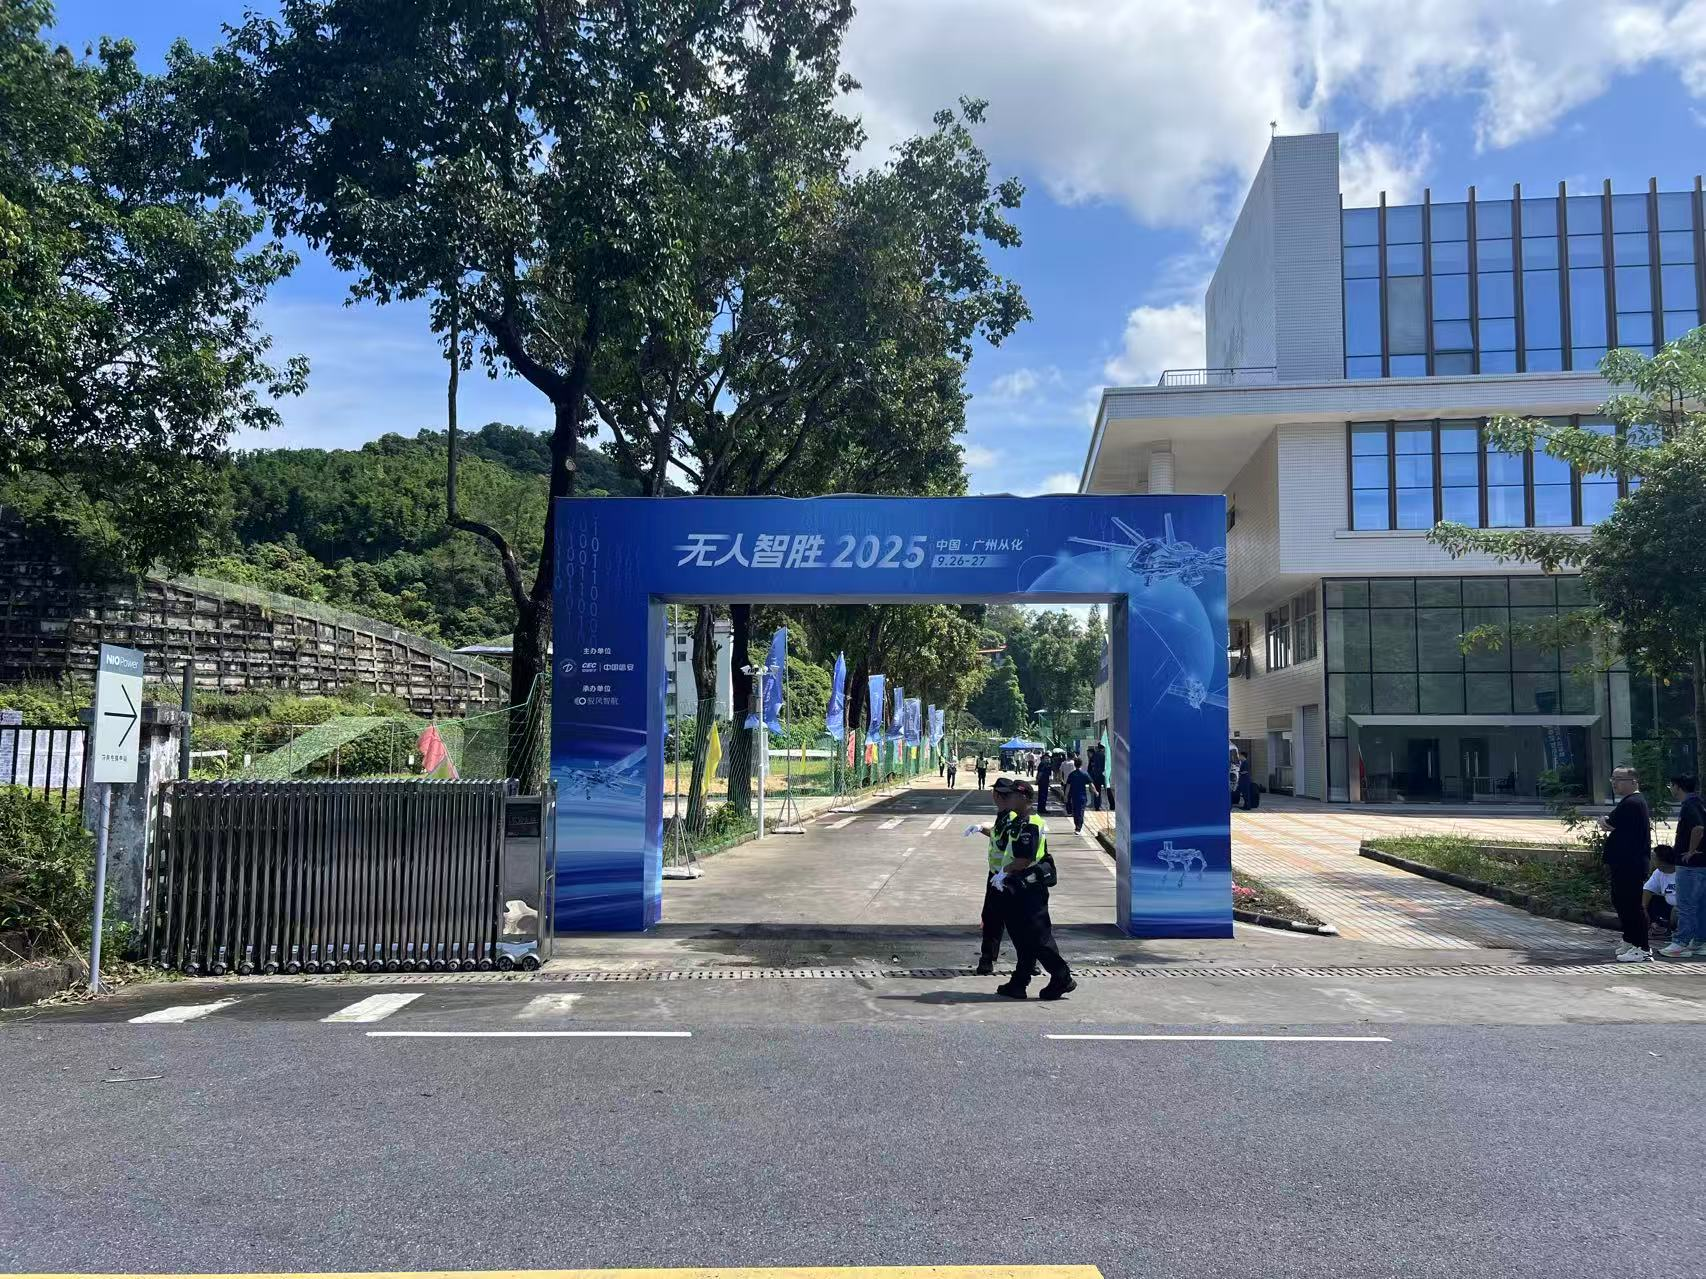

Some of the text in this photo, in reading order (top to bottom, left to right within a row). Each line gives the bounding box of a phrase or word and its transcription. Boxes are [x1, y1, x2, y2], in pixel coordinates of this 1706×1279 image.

[673, 533, 928, 569] 无人智胜 2025
[938, 556, 987, 567] 9.26-27
[583, 647, 612, 655] 主办单位
[106, 653, 120, 666] NIO
[583, 684, 611, 693] 承办单位
